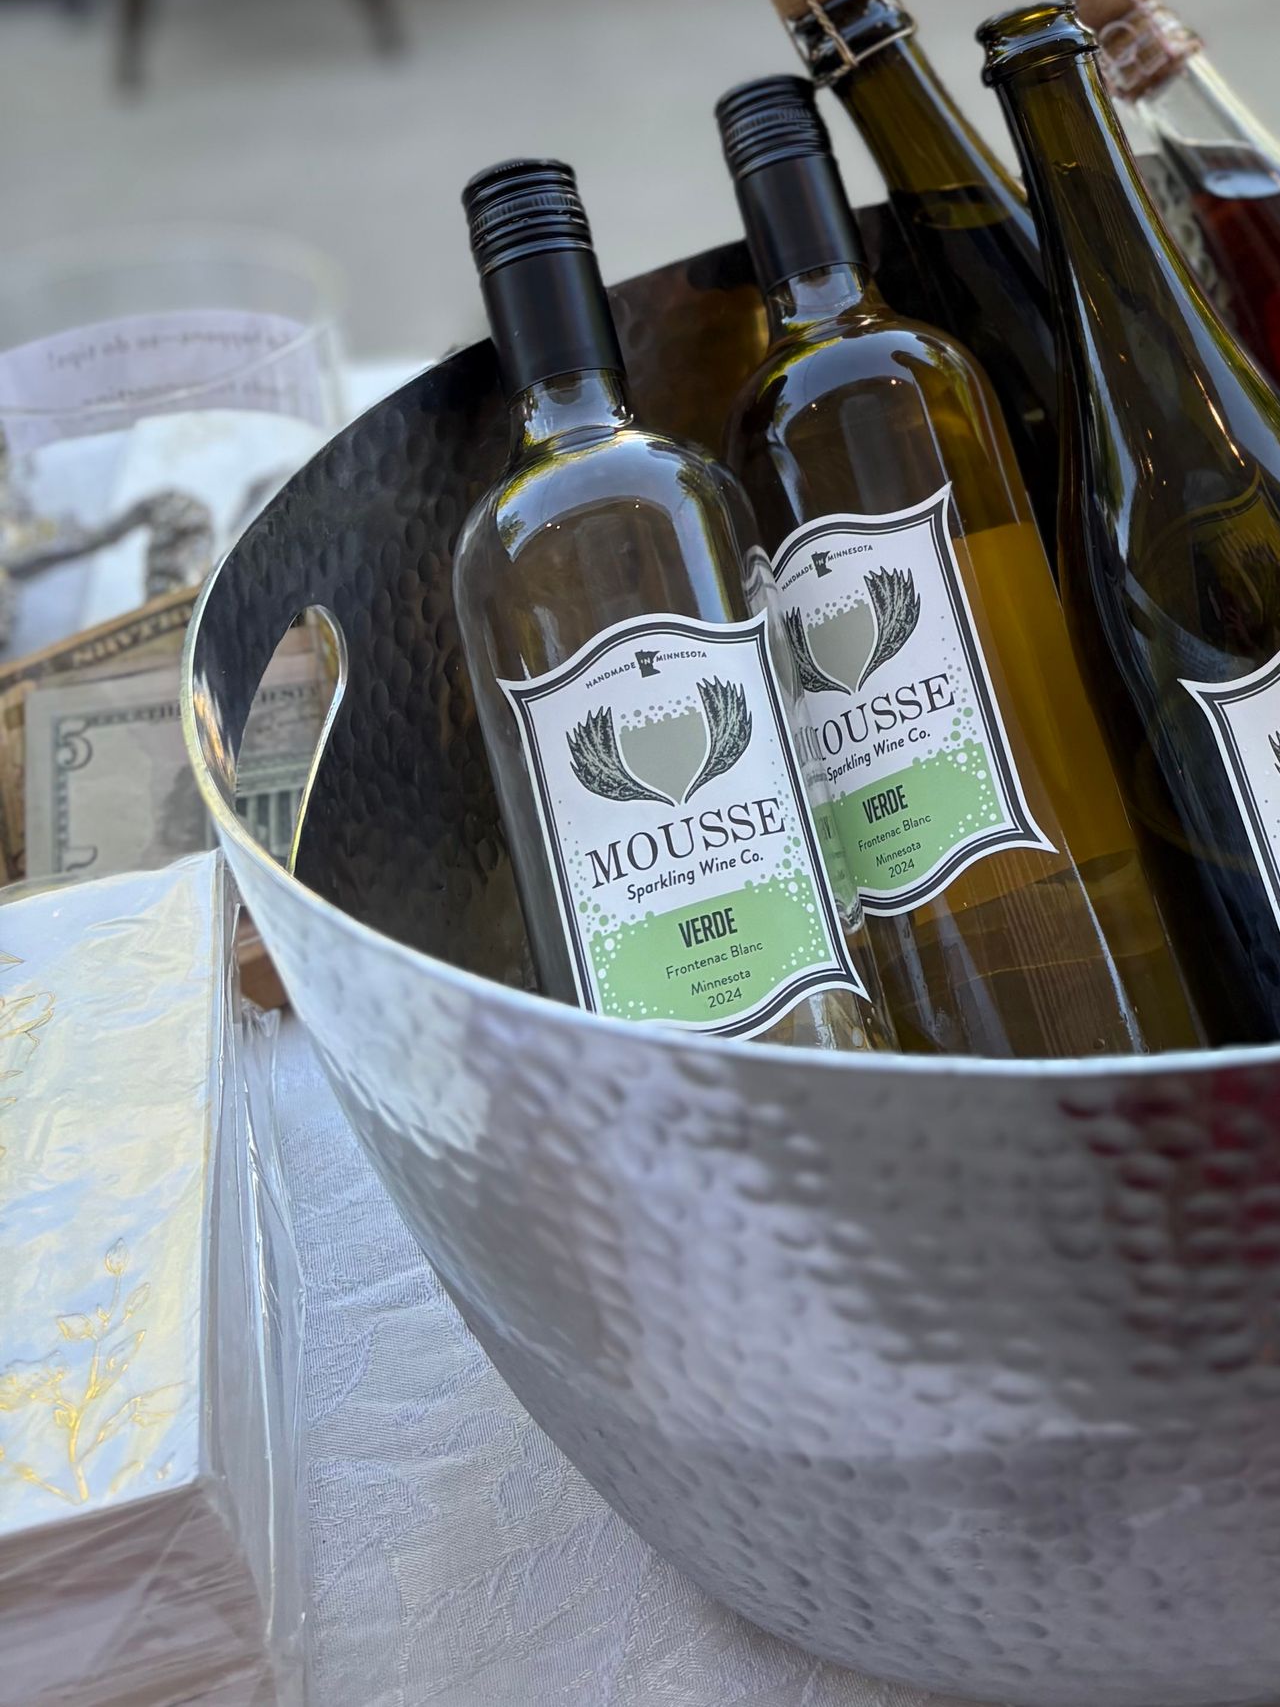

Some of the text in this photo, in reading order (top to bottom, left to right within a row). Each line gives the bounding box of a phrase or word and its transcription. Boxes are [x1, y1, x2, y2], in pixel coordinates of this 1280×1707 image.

[781, 564, 813, 591] HANDMADE
[827, 545, 873, 561] MINNESOTA
[585, 661, 636, 689] HANDMADE
[656, 651, 707, 663] MINNESOTA
[827, 729, 931, 783] Sparkling Wine Co.
[862, 785, 908, 824] VERDE
[585, 798, 786, 888] MOUSSE
[858, 813, 932, 853] Frontenac Blanc
[876, 842, 921, 867] Minnesota
[888, 861, 915, 879] 2024
[627, 848, 764, 903] Sparkling Wine Co.
[678, 908, 738, 948] VERDE
[666, 940, 763, 979] Frontenac Blanc
[690, 968, 751, 996] Minnesota
[708, 986, 743, 1009] 2024
